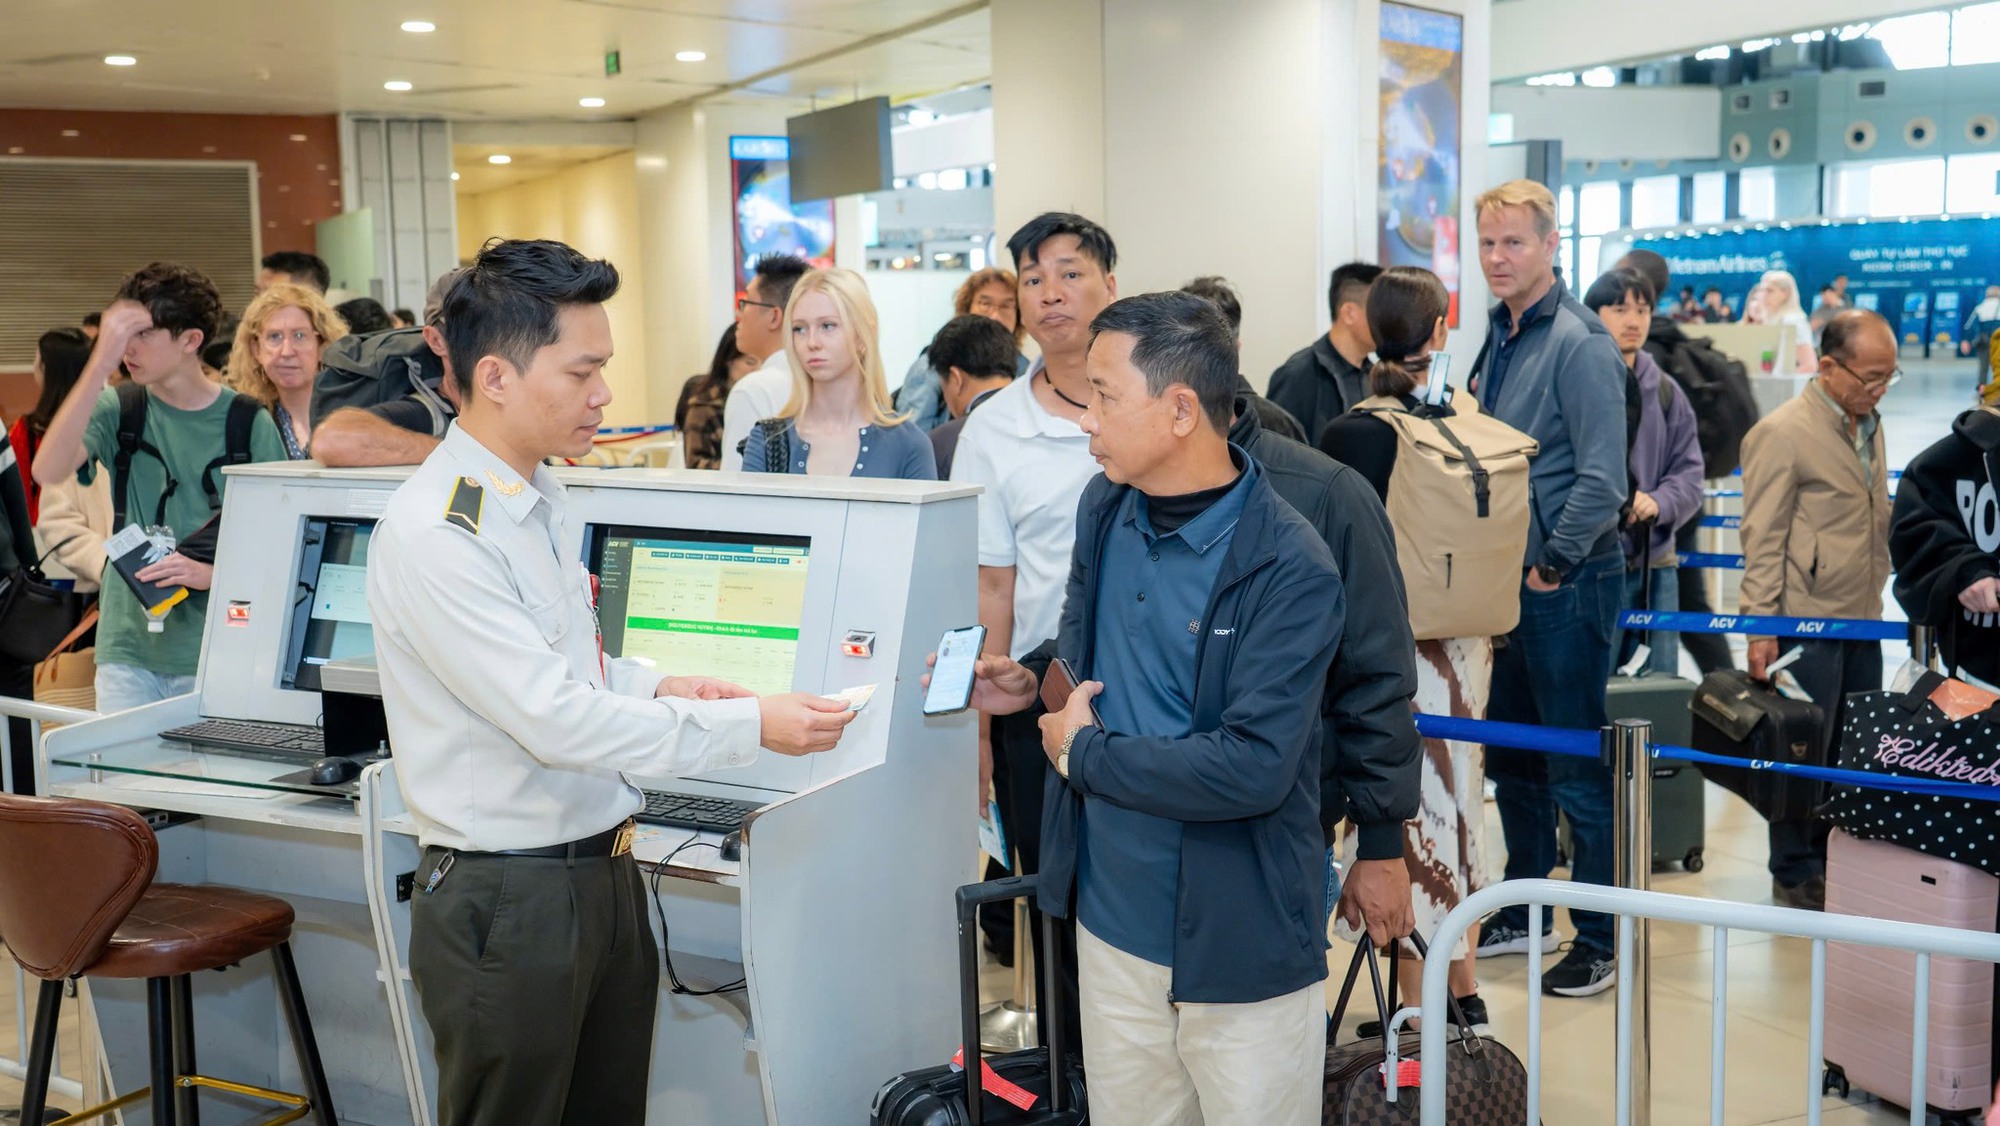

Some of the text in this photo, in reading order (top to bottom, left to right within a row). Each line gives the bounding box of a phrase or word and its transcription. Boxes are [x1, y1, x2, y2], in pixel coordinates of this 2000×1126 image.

[1626, 613, 1825, 633] ACV ACV ACV
